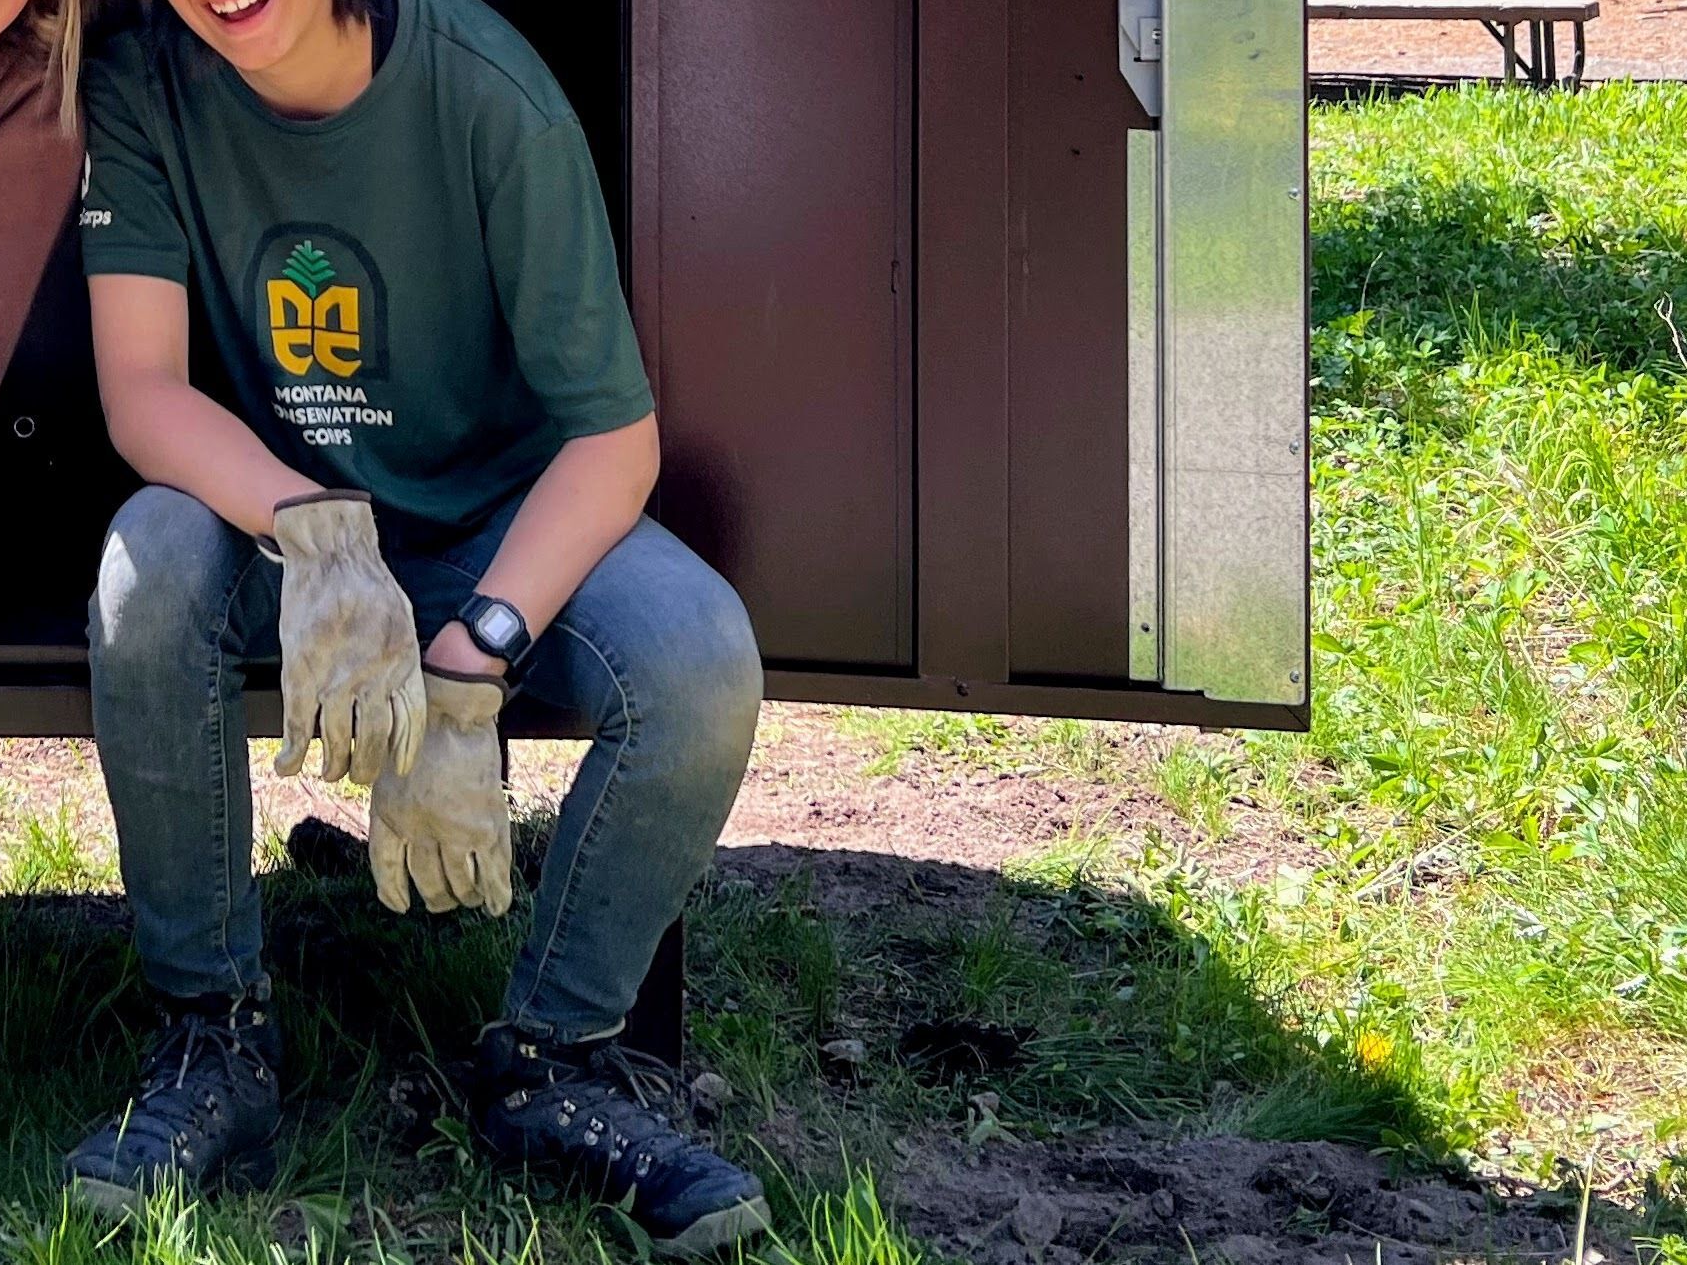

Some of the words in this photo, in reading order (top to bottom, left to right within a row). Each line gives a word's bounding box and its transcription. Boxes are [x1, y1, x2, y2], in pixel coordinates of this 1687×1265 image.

[274, 385, 367, 404] MONTANA
[272, 401, 393, 426] ONSERVATION
[302, 427, 352, 446] CORPS
